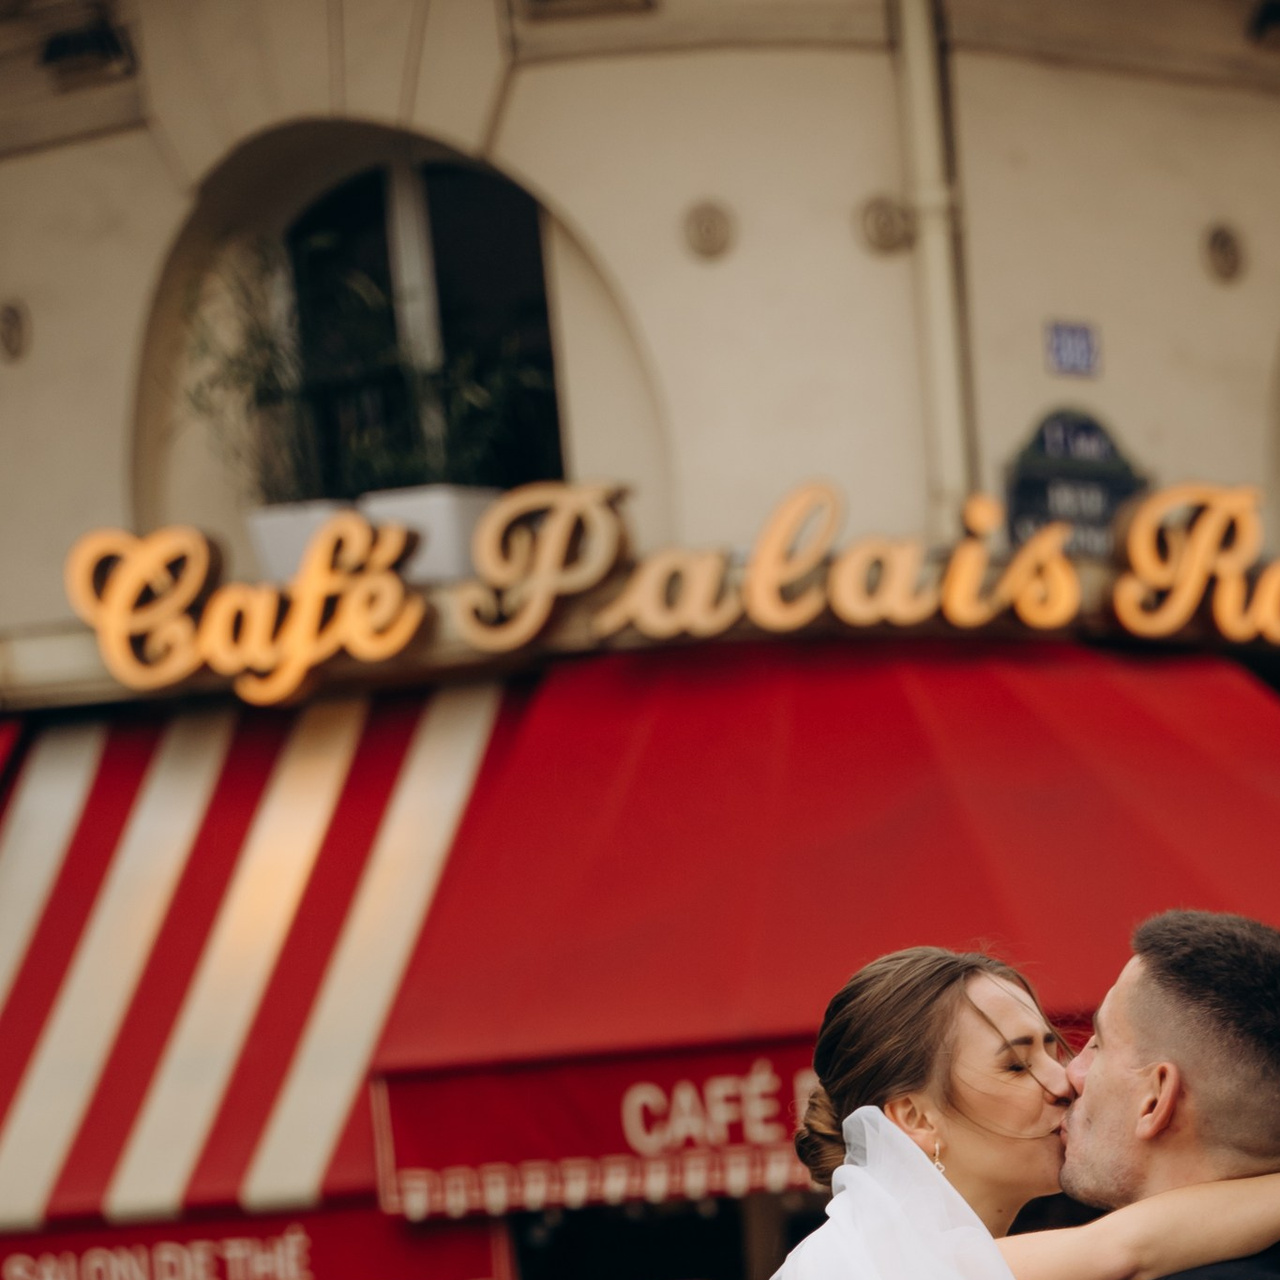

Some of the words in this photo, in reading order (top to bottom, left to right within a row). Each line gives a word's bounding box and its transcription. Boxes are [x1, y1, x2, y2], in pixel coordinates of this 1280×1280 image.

[63, 510, 425, 706] Café
[452, 478, 1082, 654] Palais
[620, 1057, 788, 1156] CAFÉ
